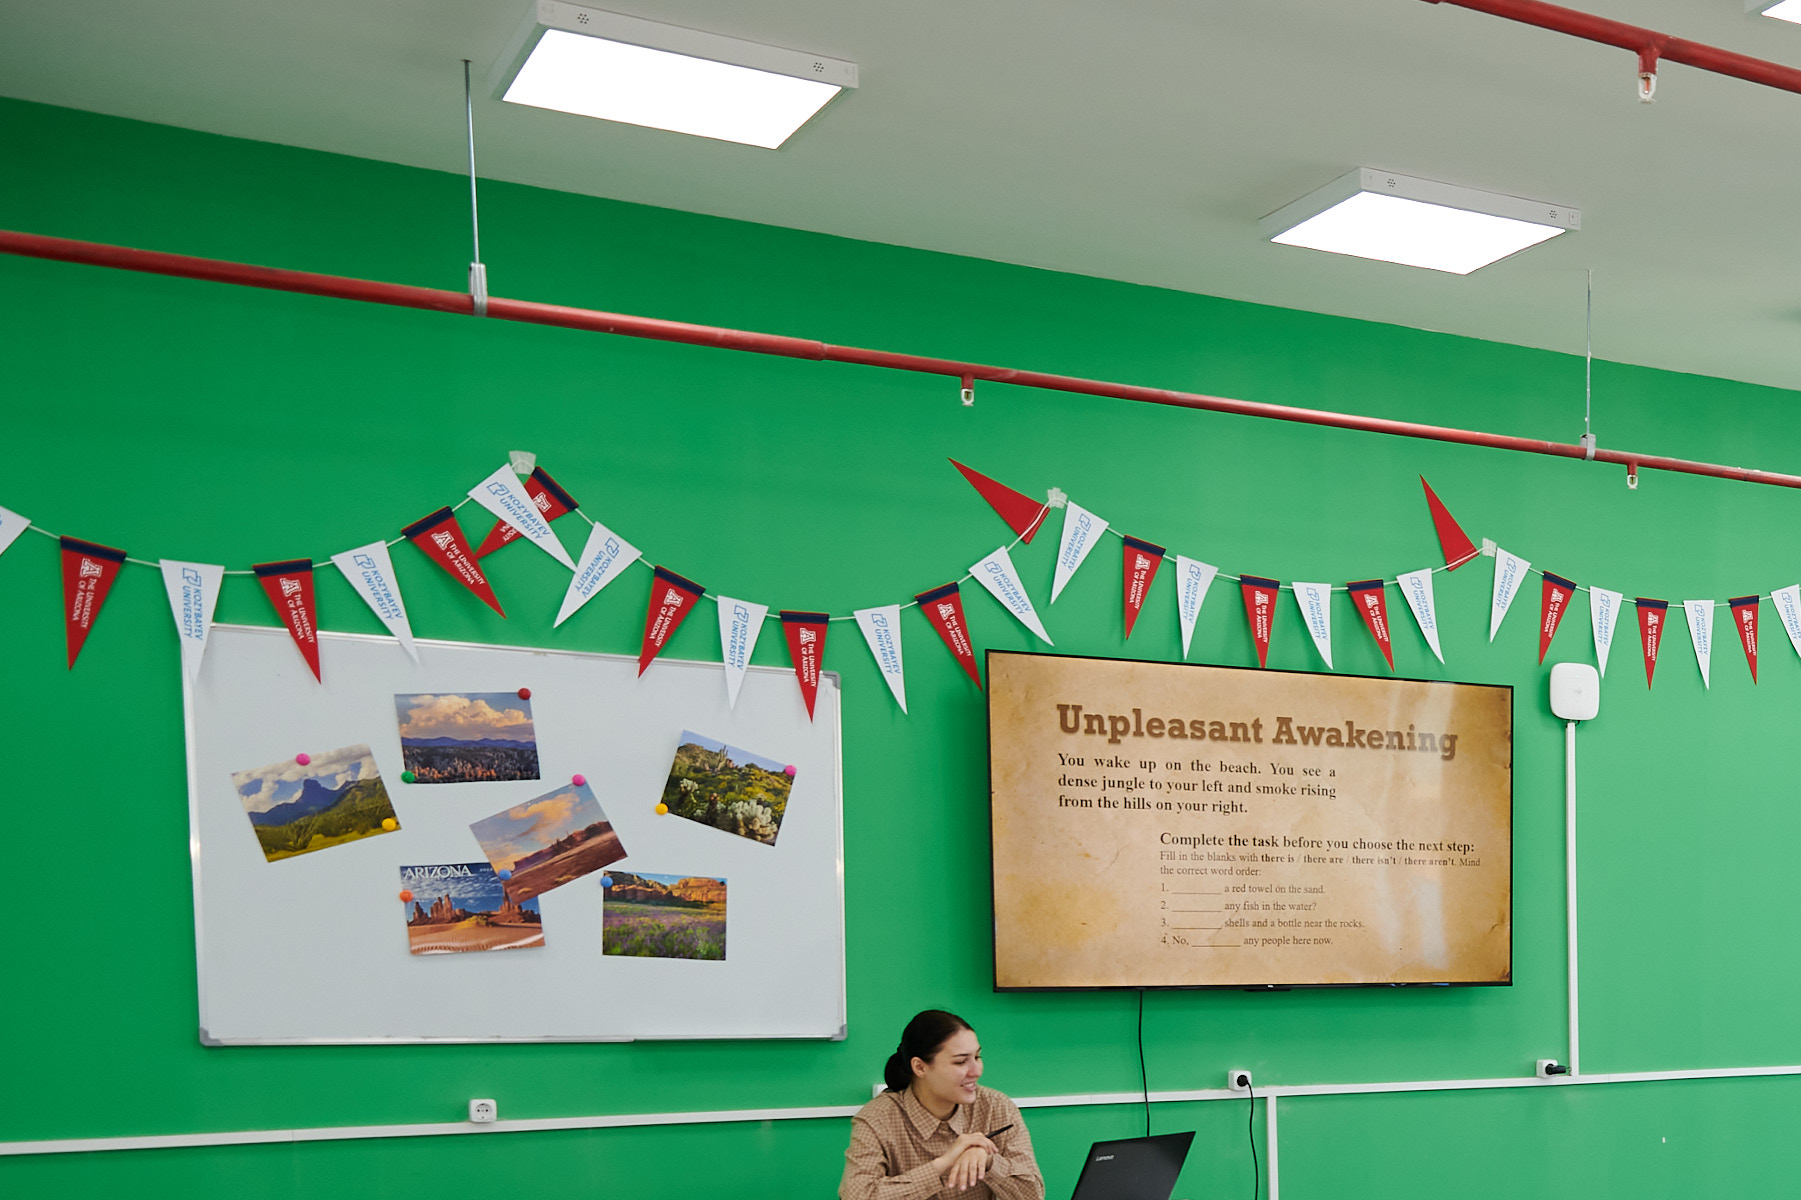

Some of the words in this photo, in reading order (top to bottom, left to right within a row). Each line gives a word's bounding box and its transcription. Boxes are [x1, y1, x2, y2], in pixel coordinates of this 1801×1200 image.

[500, 498, 543, 539] UNIVERSITY
[507, 494, 551, 535] KOZYBAYEV
[1061, 526, 1081, 567] UNIVERSITY
[1068, 532, 1087, 572] KOZYBAYEV
[452, 559, 474, 584] ARIZONA
[459, 553, 485, 585] UNIVERSITY
[575, 550, 605, 592] UNIVERSITY
[584, 558, 612, 598] KOZYBAYEV
[73, 591, 85, 621] ARIZONA
[81, 592, 94, 629] UNIVERSITY
[362, 572, 393, 620] UNIVERSITY
[372, 570, 403, 618] KOZYBAYEV
[993, 576, 1025, 614] UNIVERSITY
[1000, 573, 1031, 612] KOZYBAYEV
[183, 586, 192, 638] UNIVERSITY
[193, 589, 203, 640] KOZYBAYEV
[291, 609, 304, 639] ARIZONA
[298, 608, 314, 643] UNIVERSITY
[728, 621, 738, 667] UNIVERSITY
[736, 623, 748, 670] KOZYBAYEV
[875, 629, 893, 673] UNIVERSITY
[883, 629, 901, 674] KOZYBAYEV
[1057, 704, 1263, 744] Unpleasant
[1272, 716, 1458, 761] Awakening
[1058, 753, 1084, 766] You
[1094, 756, 1130, 768] wake
[1140, 761, 1156, 772] up
[1166, 760, 1181, 771] on
[1191, 760, 1211, 771] the
[1220, 761, 1261, 774] beach.
[1270, 763, 1293, 775] You
[1302, 766, 1321, 777] see
[1329, 769, 1335, 777] a
[1058, 774, 1097, 787] dense
[1102, 776, 1145, 791] jungle
[1150, 779, 1162, 790] to
[1167, 780, 1198, 793] your
[1202, 780, 1223, 792] left
[1228, 782, 1251, 793] and
[1256, 783, 1296, 795] smoke
[1301, 784, 1336, 799] rising
[1059, 795, 1092, 808] from
[1098, 797, 1119, 808] the
[1124, 797, 1151, 810] hills
[1156, 801, 1172, 811] on
[1177, 802, 1207, 814] your
[1212, 801, 1248, 815] right.
[1160, 833, 1224, 849] Complete
[1228, 835, 1248, 846] the
[1253, 836, 1279, 847] task
[1284, 837, 1322, 848] before
[1327, 840, 1348, 851] you
[1353, 838, 1393, 850] choose
[1396, 839, 1414, 850] the
[1419, 841, 1443, 851] next
[1447, 842, 1475, 855] step:
[1160, 851, 1175, 860] Fill
[1179, 852, 1187, 860] in
[1191, 852, 1204, 861] the
[1207, 853, 1236, 862] blanks
[1239, 854, 1258, 862] with
[1261, 854, 1285, 862] there
[1288, 854, 1294, 862] is
[1304, 854, 1327, 863] there
[1352, 856, 1374, 864] there
[1378, 857, 1396, 865] isn't
[1405, 857, 1426, 865] there
[1429, 858, 1456, 866] aren't.
[1459, 858, 1480, 866] Mind
[404, 865, 472, 879] ARIZONA
[1160, 866, 1173, 874] the
[1177, 866, 1208, 875] correct
[1211, 867, 1233, 875] word
[1236, 867, 1261, 876] order:
[1161, 883, 1168, 892] 1.
[1232, 884, 1246, 892] red
[1249, 885, 1272, 893] towel
[1289, 884, 1301, 893] the
[1304, 885, 1325, 894] sand.
[1161, 901, 1169, 910] 2.
[1225, 903, 1241, 912] any
[1243, 901, 1259, 910] fish
[1262, 902, 1270, 910] in
[1273, 902, 1286, 910] the
[1289, 902, 1316, 911] water?
[1161, 918, 1169, 927] 3.
[1225, 919, 1249, 927] shells
[1252, 919, 1267, 927] and
[1278, 919, 1301, 928] bottle
[1325, 919, 1337, 927] the
[1161, 936, 1169, 944] 4.
[1172, 936, 1189, 945] No,
[1244, 939, 1259, 947] any
[1262, 937, 1290, 947] people
